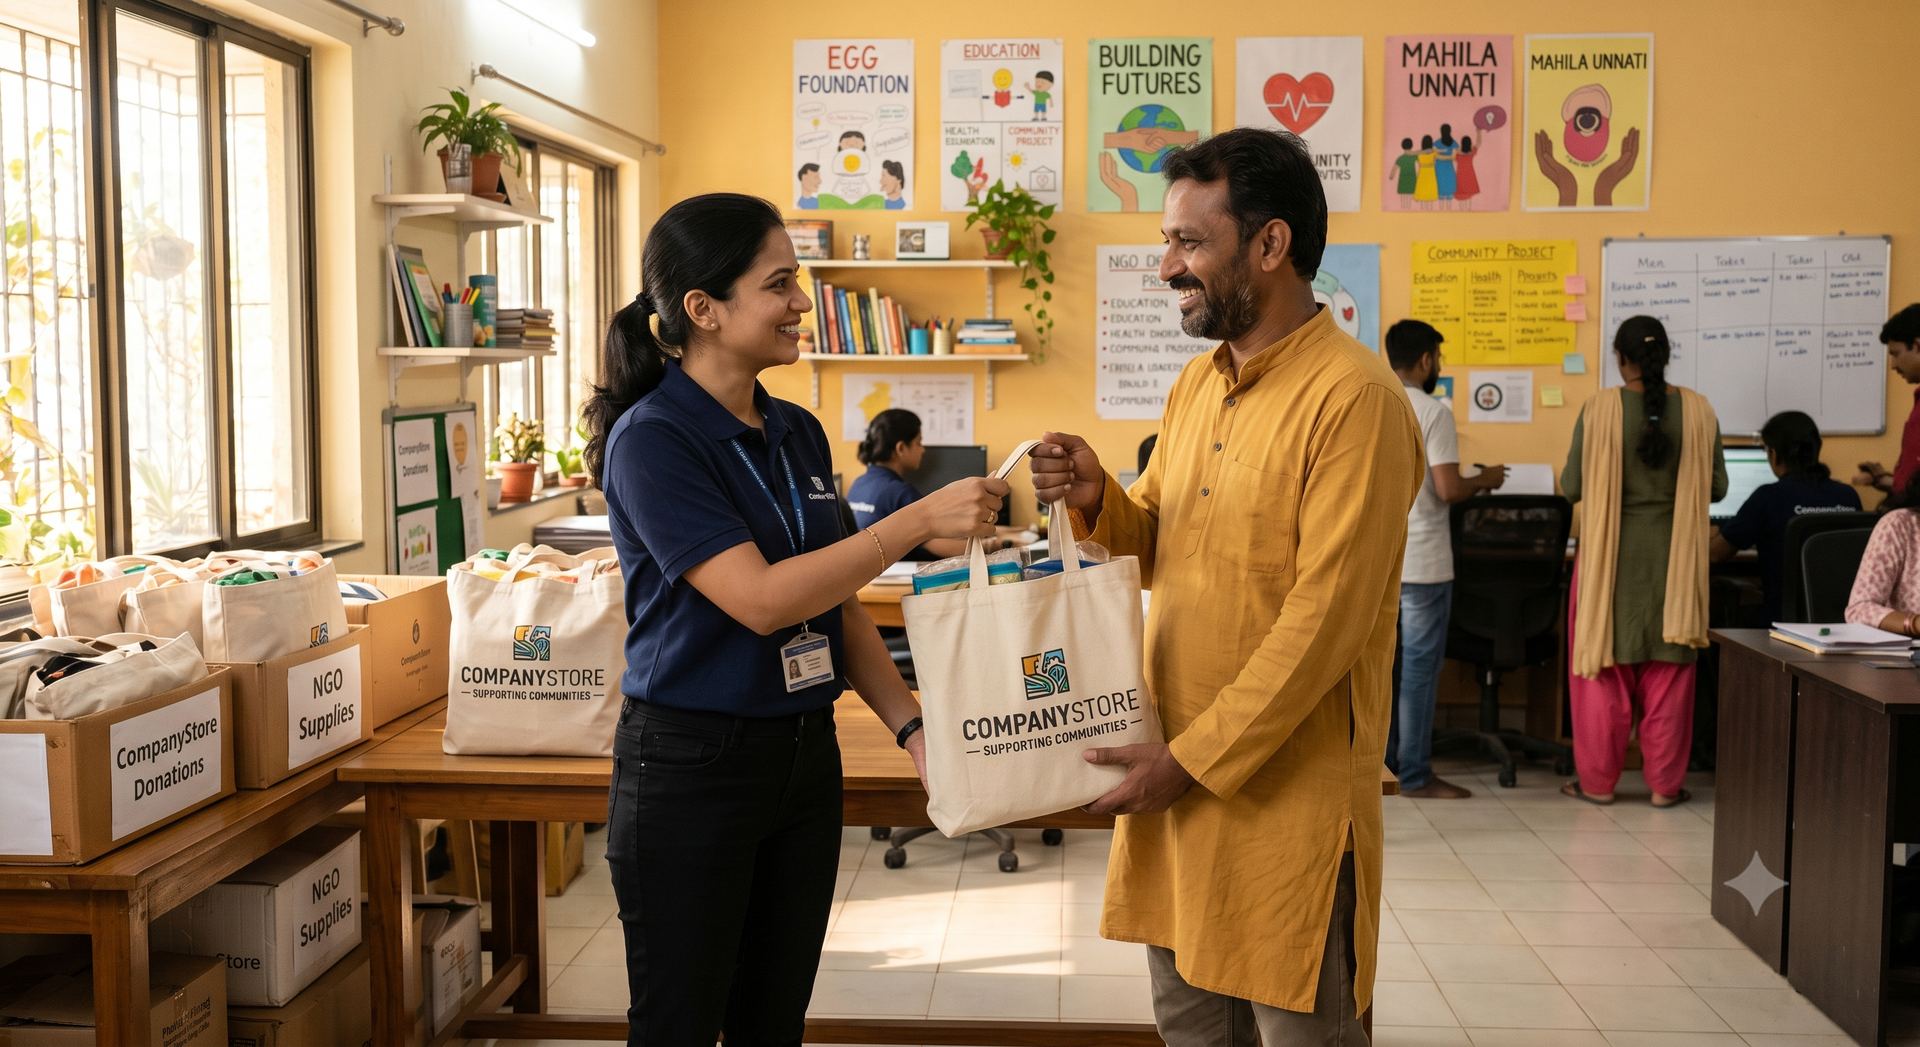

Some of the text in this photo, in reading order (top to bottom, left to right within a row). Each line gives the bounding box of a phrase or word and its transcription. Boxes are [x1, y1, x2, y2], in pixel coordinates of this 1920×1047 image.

[827, 45, 878, 70] EGG
[963, 43, 1040, 58] EDUCATION
[1099, 44, 1202, 68] BUILDING
[1402, 41, 1498, 68] MAHILA
[1530, 52, 1648, 71] MAHILA UNNATI
[799, 75, 909, 94] FOUNDATION
[1102, 72, 1202, 96] FUTURES
[1408, 72, 1496, 98] UNNATI
[945, 126, 980, 136] HEALTH
[1007, 126, 1060, 136] COMMUNITY
[1015, 136, 1054, 146] PROJECT
[1108, 254, 1139, 269] NGO
[1428, 244, 1557, 261] COMMUNITY PROJECT
[1413, 272, 1458, 285] Education
[1110, 298, 1169, 309] EDUCATION
[1110, 314, 1162, 324] EDUCATION
[312, 668, 343, 699] NGO
[461, 666, 605, 687] COMPANYSTORE
[473, 689, 591, 700] SUPPORTING COMMUNITIES
[299, 703, 354, 740] Supplies
[962, 689, 1140, 741] COMPANYSTORE
[116, 716, 218, 771] CompanyStore
[983, 719, 1128, 756] SUPPORTING COMMUNITIES
[134, 756, 204, 801] Donations
[312, 868, 340, 904] NGO
[300, 897, 352, 947] Supplies
[216, 953, 261, 969] tore
